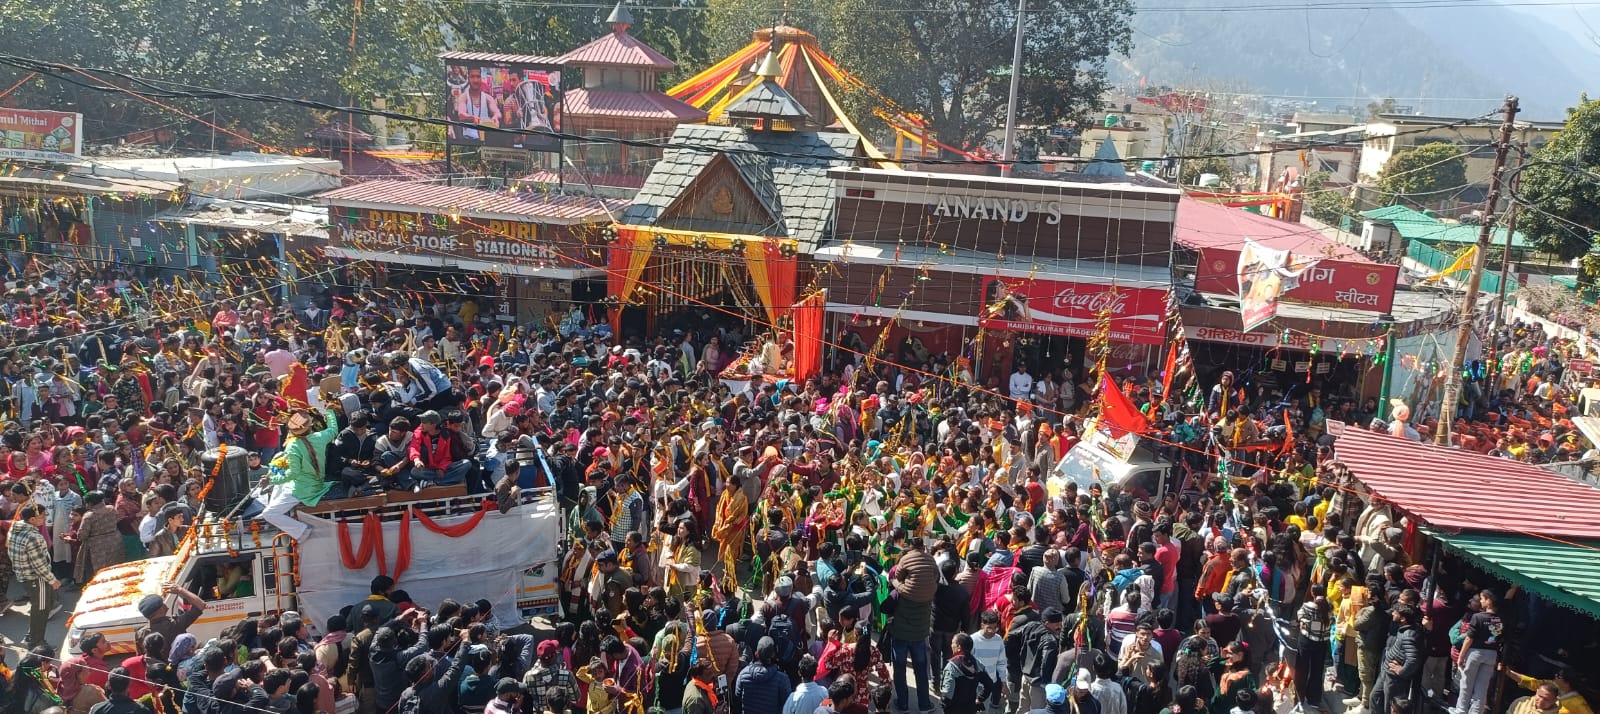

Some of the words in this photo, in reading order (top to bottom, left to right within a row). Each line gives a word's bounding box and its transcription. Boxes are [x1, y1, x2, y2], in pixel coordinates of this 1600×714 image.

[0, 113, 17, 124] mul
[19, 114, 48, 126] Mithai
[342, 230, 403, 246] MEDICAL
[412, 234, 457, 250] STORE
[1054, 287, 1129, 314] Coca-Cola
[1037, 325, 1064, 333] KUMAR
